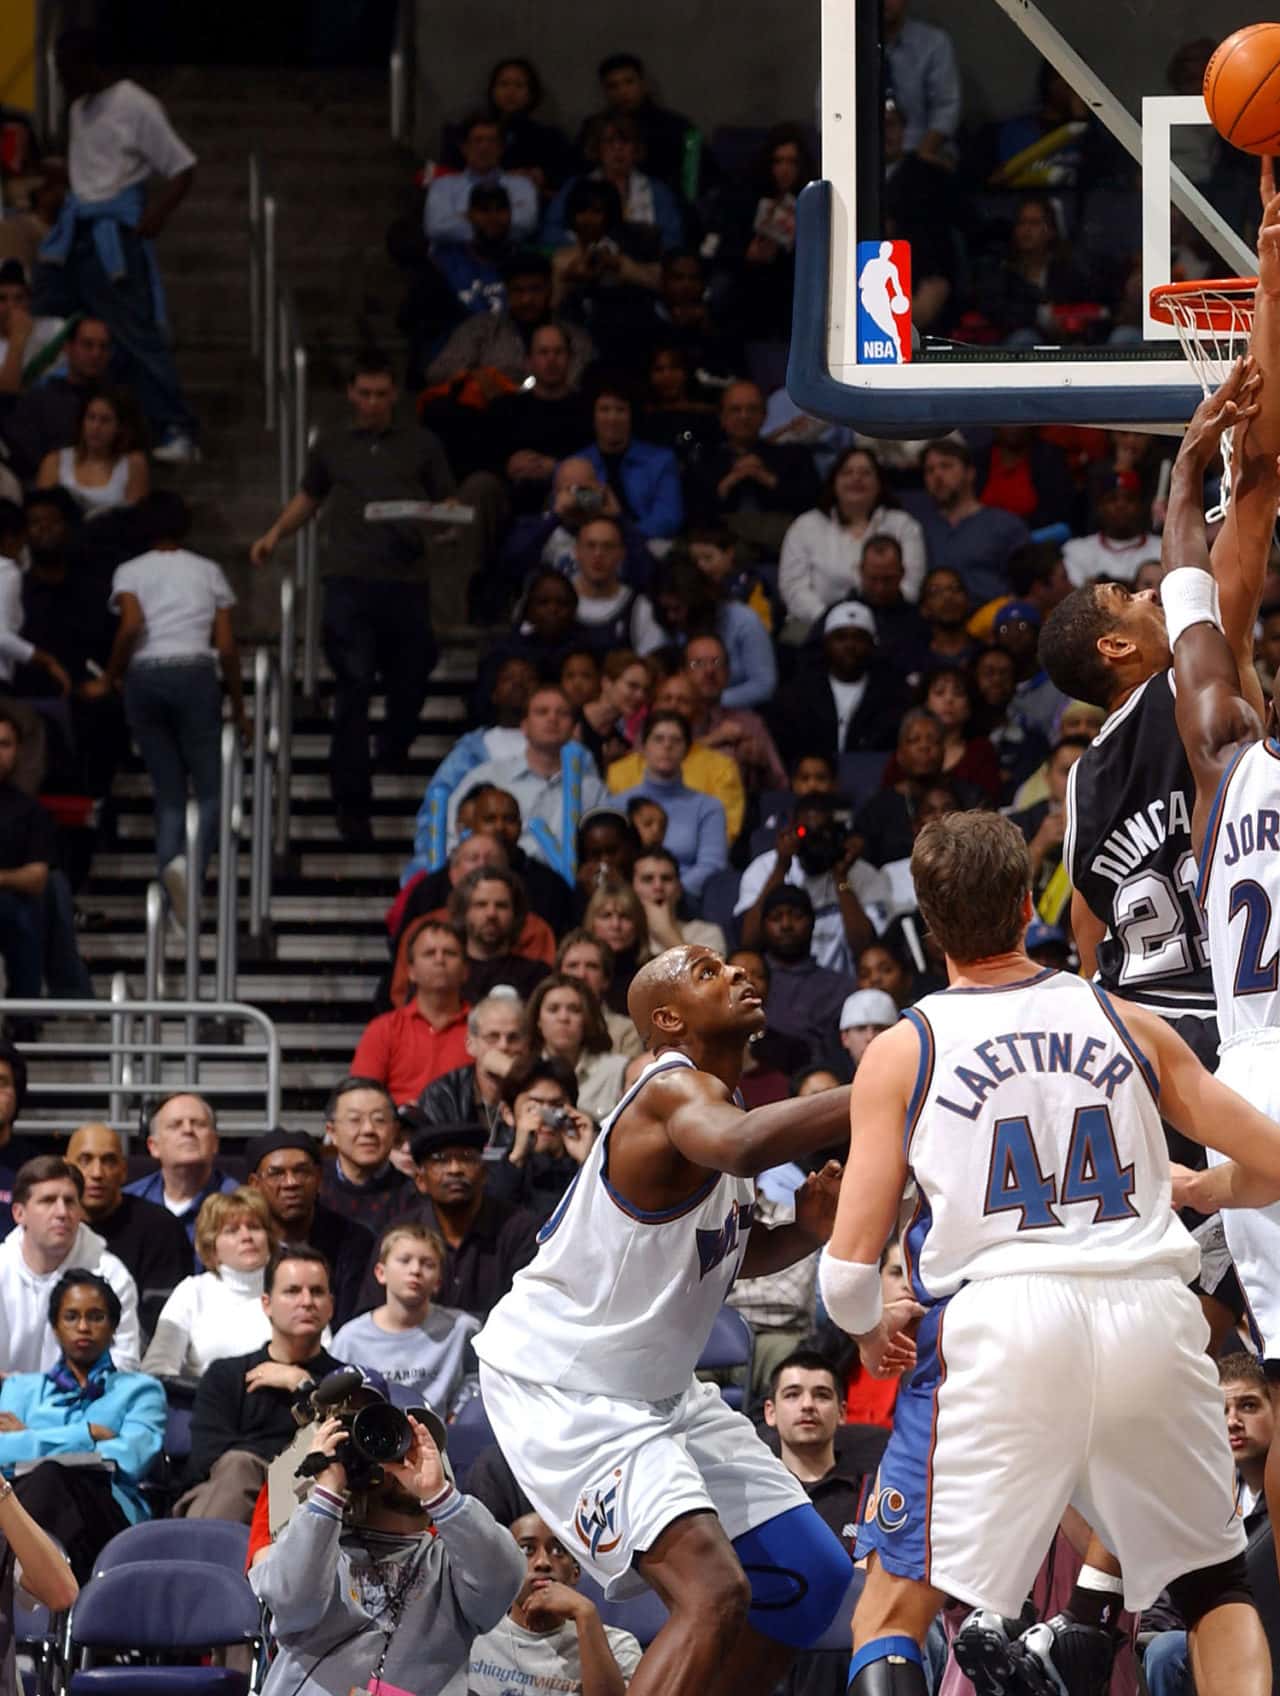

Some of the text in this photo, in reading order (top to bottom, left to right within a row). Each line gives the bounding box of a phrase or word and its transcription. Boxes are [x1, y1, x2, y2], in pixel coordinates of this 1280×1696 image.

[863, 341, 895, 359] NBA
[1091, 791, 1191, 884] DUNCA
[935, 1031, 1134, 1121] LAETTNER
[983, 1104, 1141, 1232] 44
